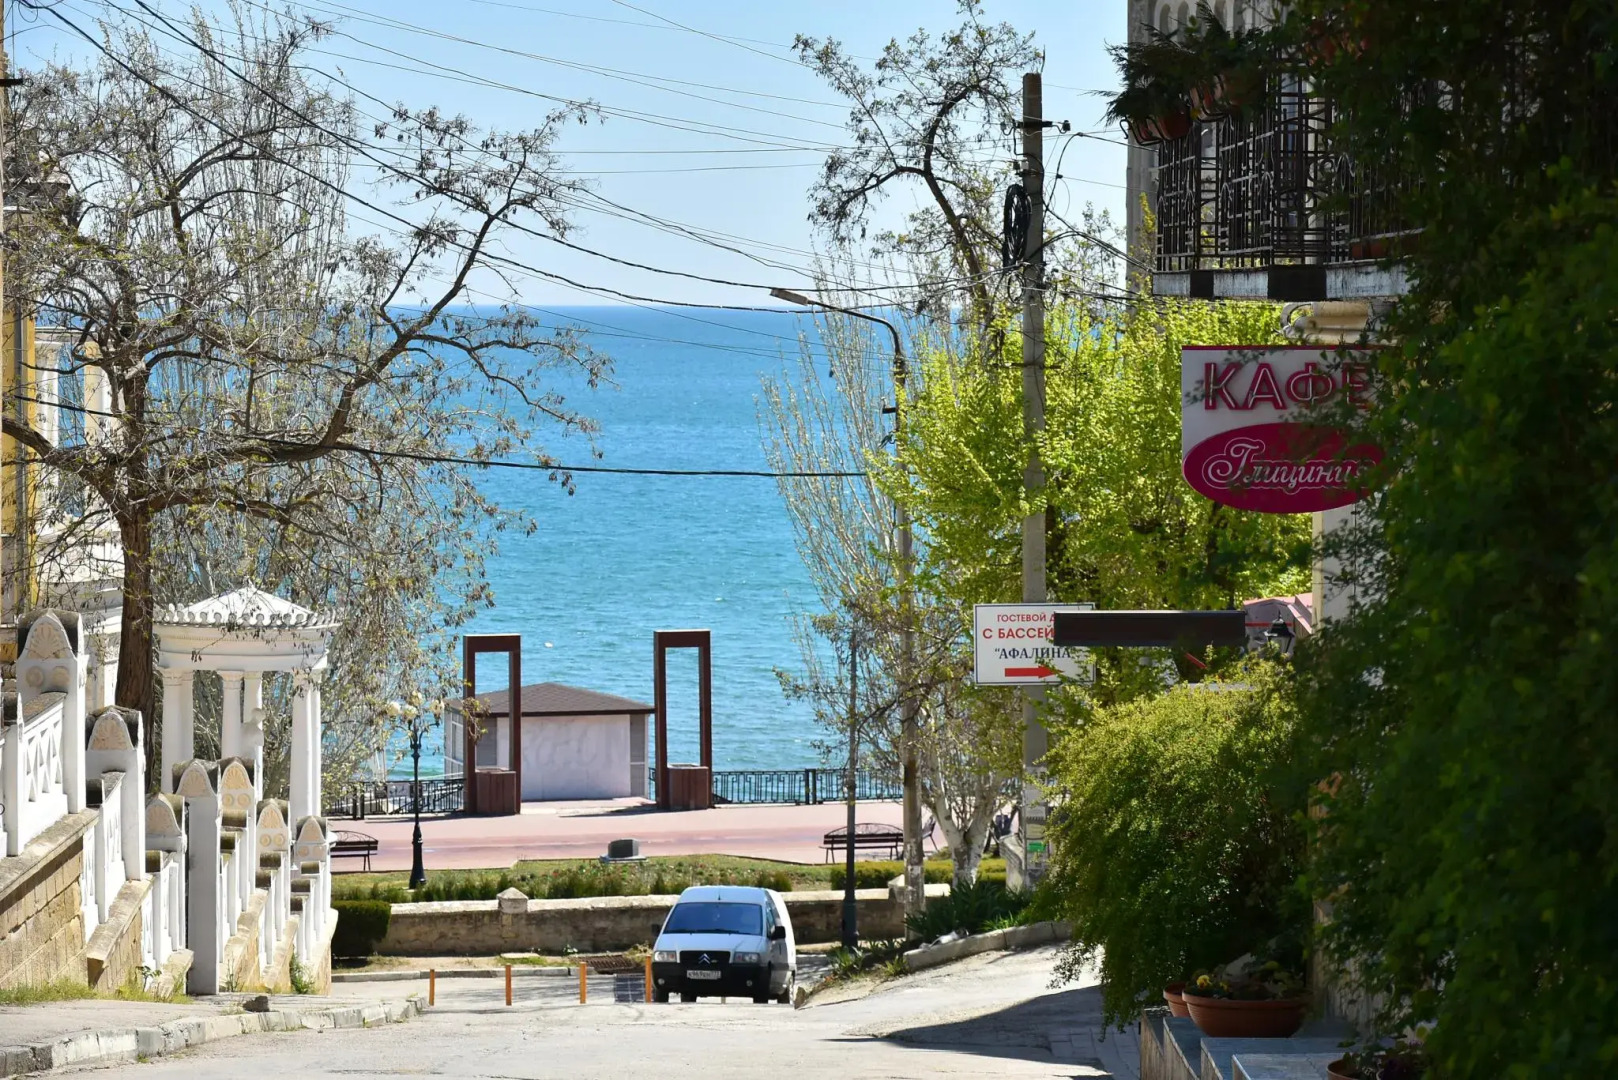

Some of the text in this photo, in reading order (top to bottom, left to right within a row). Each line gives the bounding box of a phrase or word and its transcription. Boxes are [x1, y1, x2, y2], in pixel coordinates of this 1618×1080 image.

[1204, 362, 1369, 411] КАФЕ
[997, 613, 1046, 623] ГОСТЕВОЙ
[982, 625, 1055, 639] С БАССЕЙ
